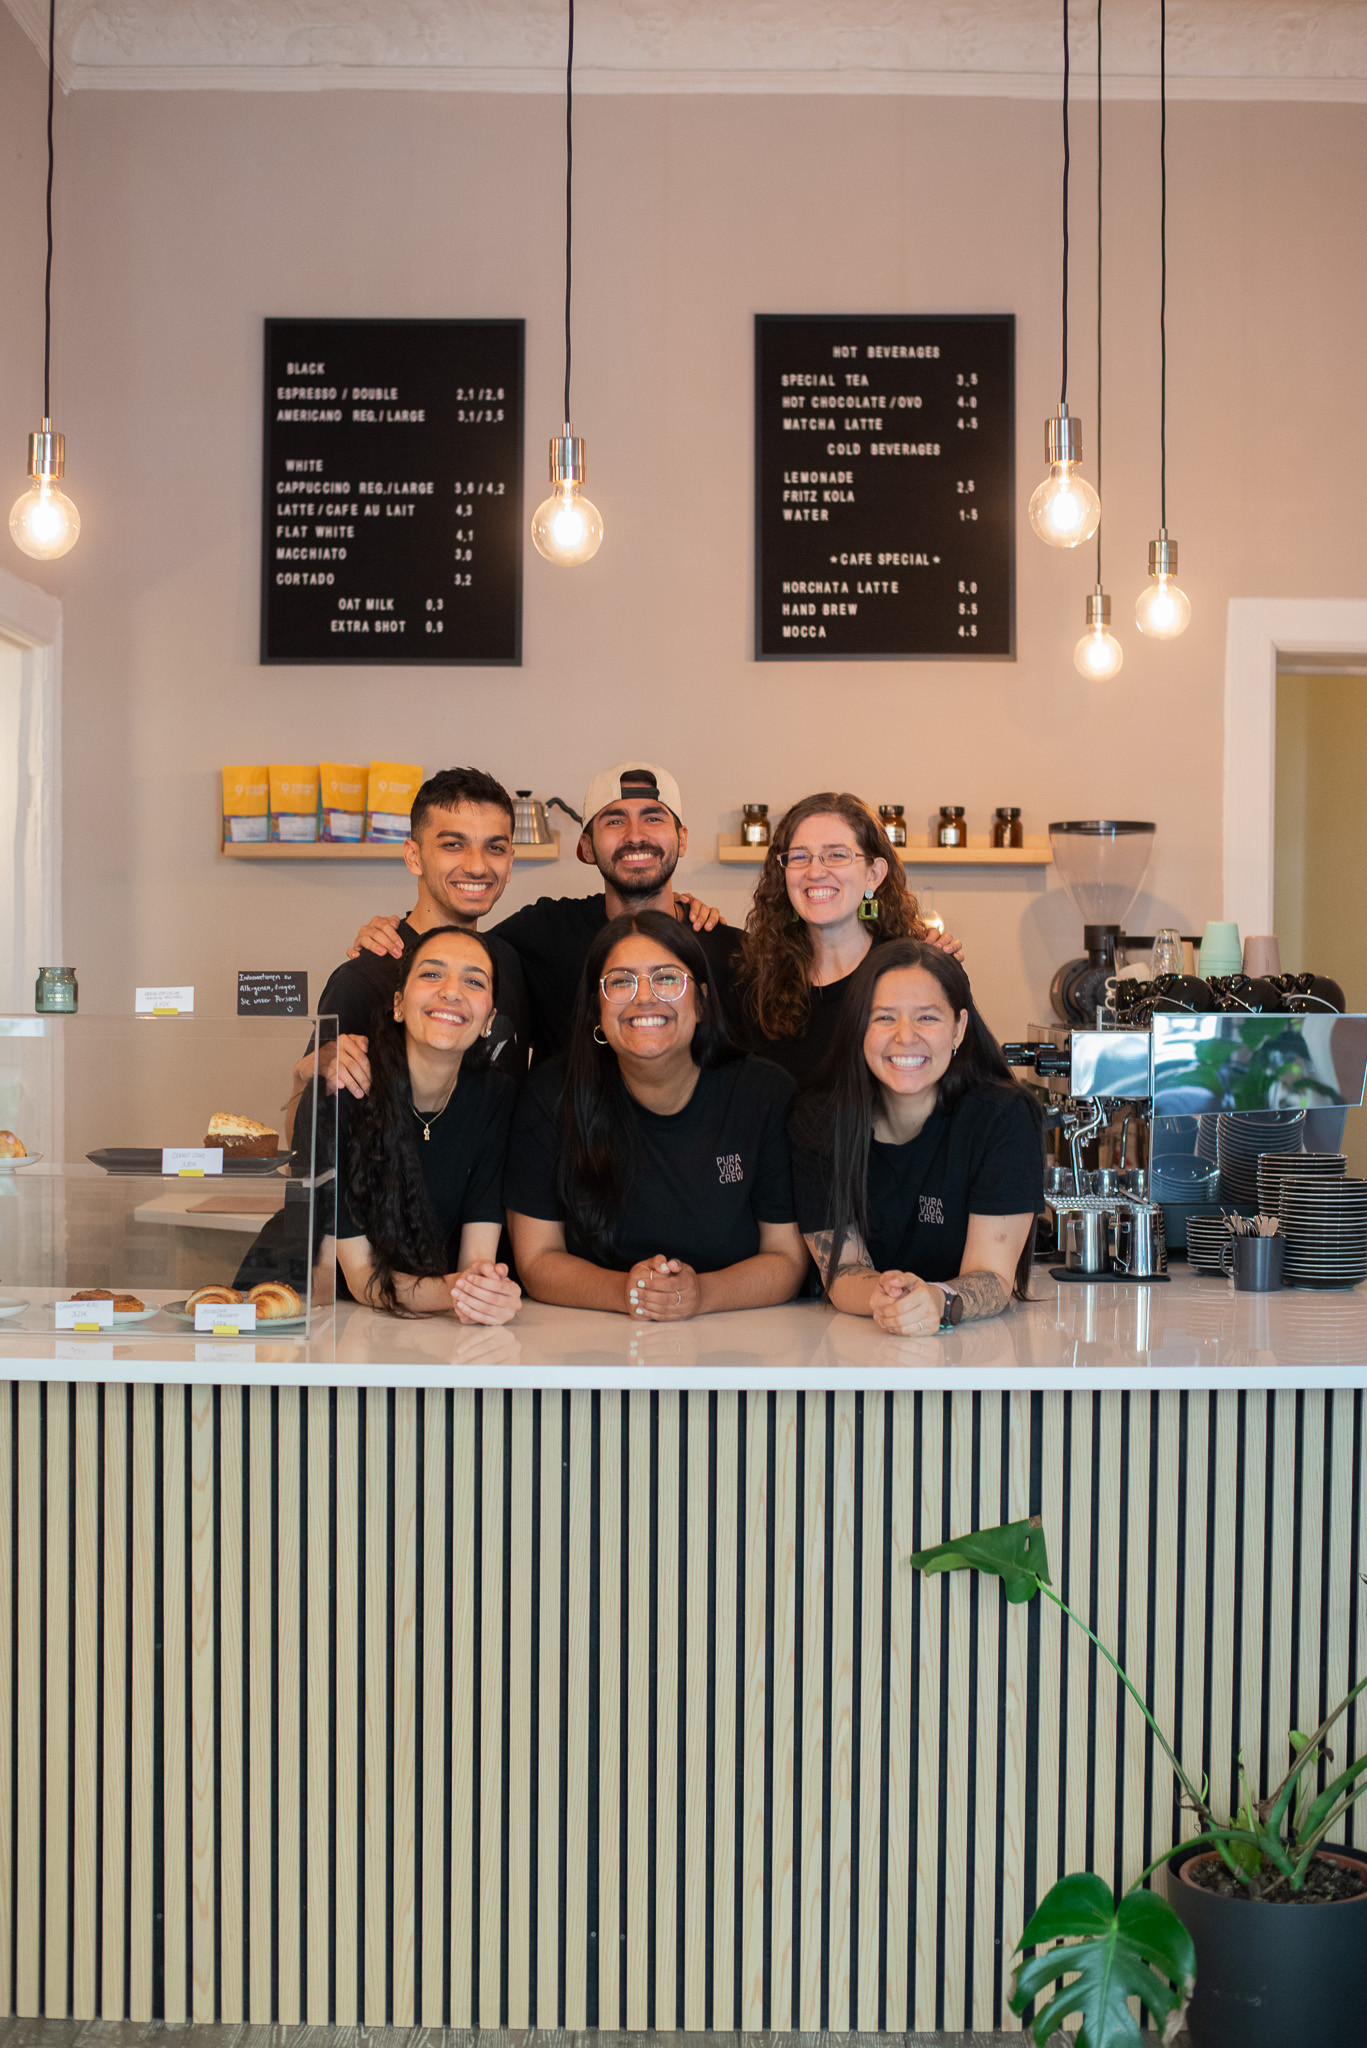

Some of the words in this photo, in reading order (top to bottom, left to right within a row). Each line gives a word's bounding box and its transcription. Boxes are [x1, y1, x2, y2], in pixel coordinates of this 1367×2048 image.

[832, 345, 858, 359] HOT
[866, 345, 941, 359] BEVERAGES
[286, 362, 325, 375] BLACK
[781, 373, 836, 387] SPECIAL
[844, 373, 870, 387] TEA
[781, 395, 806, 409] HOT
[276, 408, 343, 423] AMERICANO
[782, 417, 836, 431] MATCHA
[844, 417, 883, 431] LATTE
[826, 442, 862, 457] COLD
[870, 442, 941, 457] BEVERAGES
[285, 459, 323, 472] WHITE
[783, 470, 854, 484] LEMONADE
[276, 480, 351, 495] CAPPUCCINO
[782, 489, 818, 503] FRITZ
[822, 489, 855, 503] KOLA
[363, 503, 380, 517] AU
[386, 503, 416, 517] LAIT
[782, 508, 829, 522] WATER
[276, 525, 308, 539] FLAT
[314, 525, 355, 539] WHITE
[276, 547, 347, 561] MACCHIATO
[839, 552, 873, 566] CAFE
[877, 552, 930, 566] SPECIAL
[275, 572, 335, 586] CORTADO
[782, 580, 850, 594] HORCHATA
[856, 580, 899, 594] LATTE
[337, 597, 361, 612] OAT
[365, 597, 394, 612] MILK
[781, 602, 817, 617] HAND
[821, 602, 858, 617] BREW
[330, 619, 370, 634] EXTRA
[374, 619, 406, 634] SHOT
[782, 624, 827, 639] MOCCA
[716, 1153, 742, 1166] PURA
[718, 1162, 742, 1175] VIDA
[719, 1170, 744, 1184] CREW
[918, 1195, 943, 1208] PURA
[919, 1204, 943, 1216] VIDA
[918, 1213, 945, 1224] CREW
